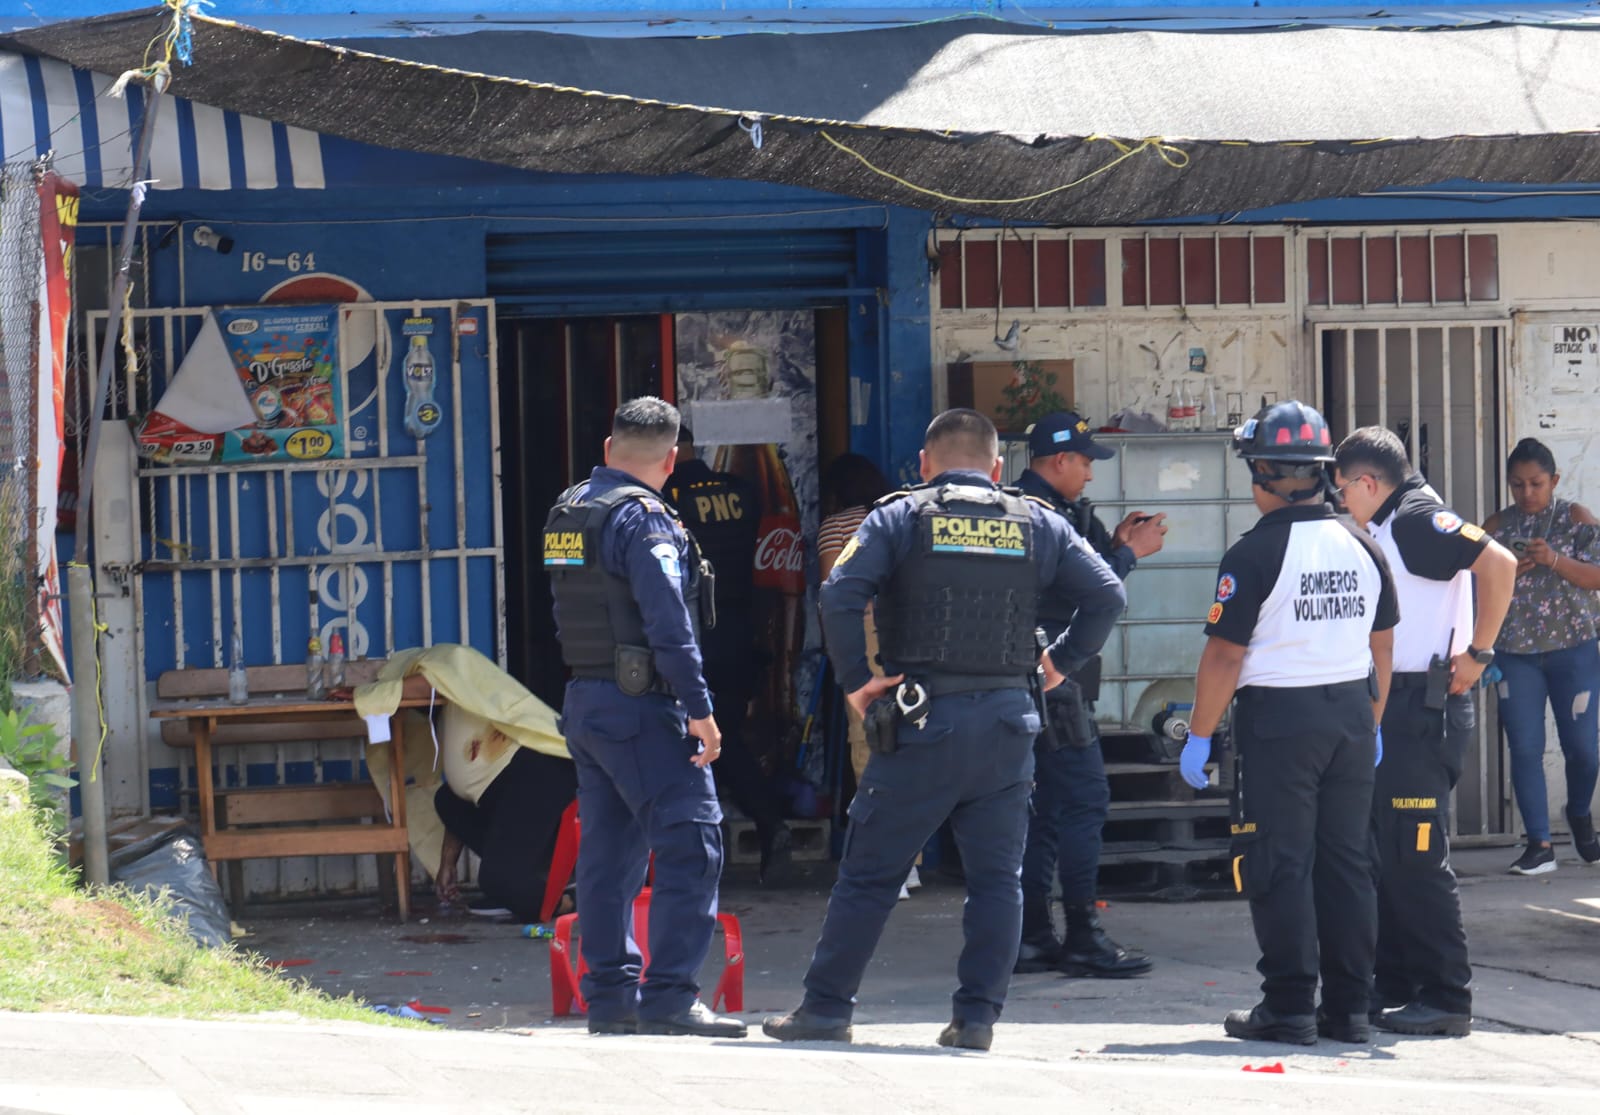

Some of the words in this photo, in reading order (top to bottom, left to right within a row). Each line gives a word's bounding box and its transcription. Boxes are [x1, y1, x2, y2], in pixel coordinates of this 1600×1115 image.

[242, 251, 316, 272] 16-64
[1563, 327, 1591, 342] NO
[694, 492, 743, 524] PNC
[931, 516, 1025, 541] POLICIA
[543, 532, 584, 550] POLICIA
[932, 534, 994, 548] NACIONAL
[994, 538, 1025, 550] CIVIL
[1300, 570, 1358, 596] BOMBEROS
[1293, 595, 1366, 622] VOLUNTARIOS
